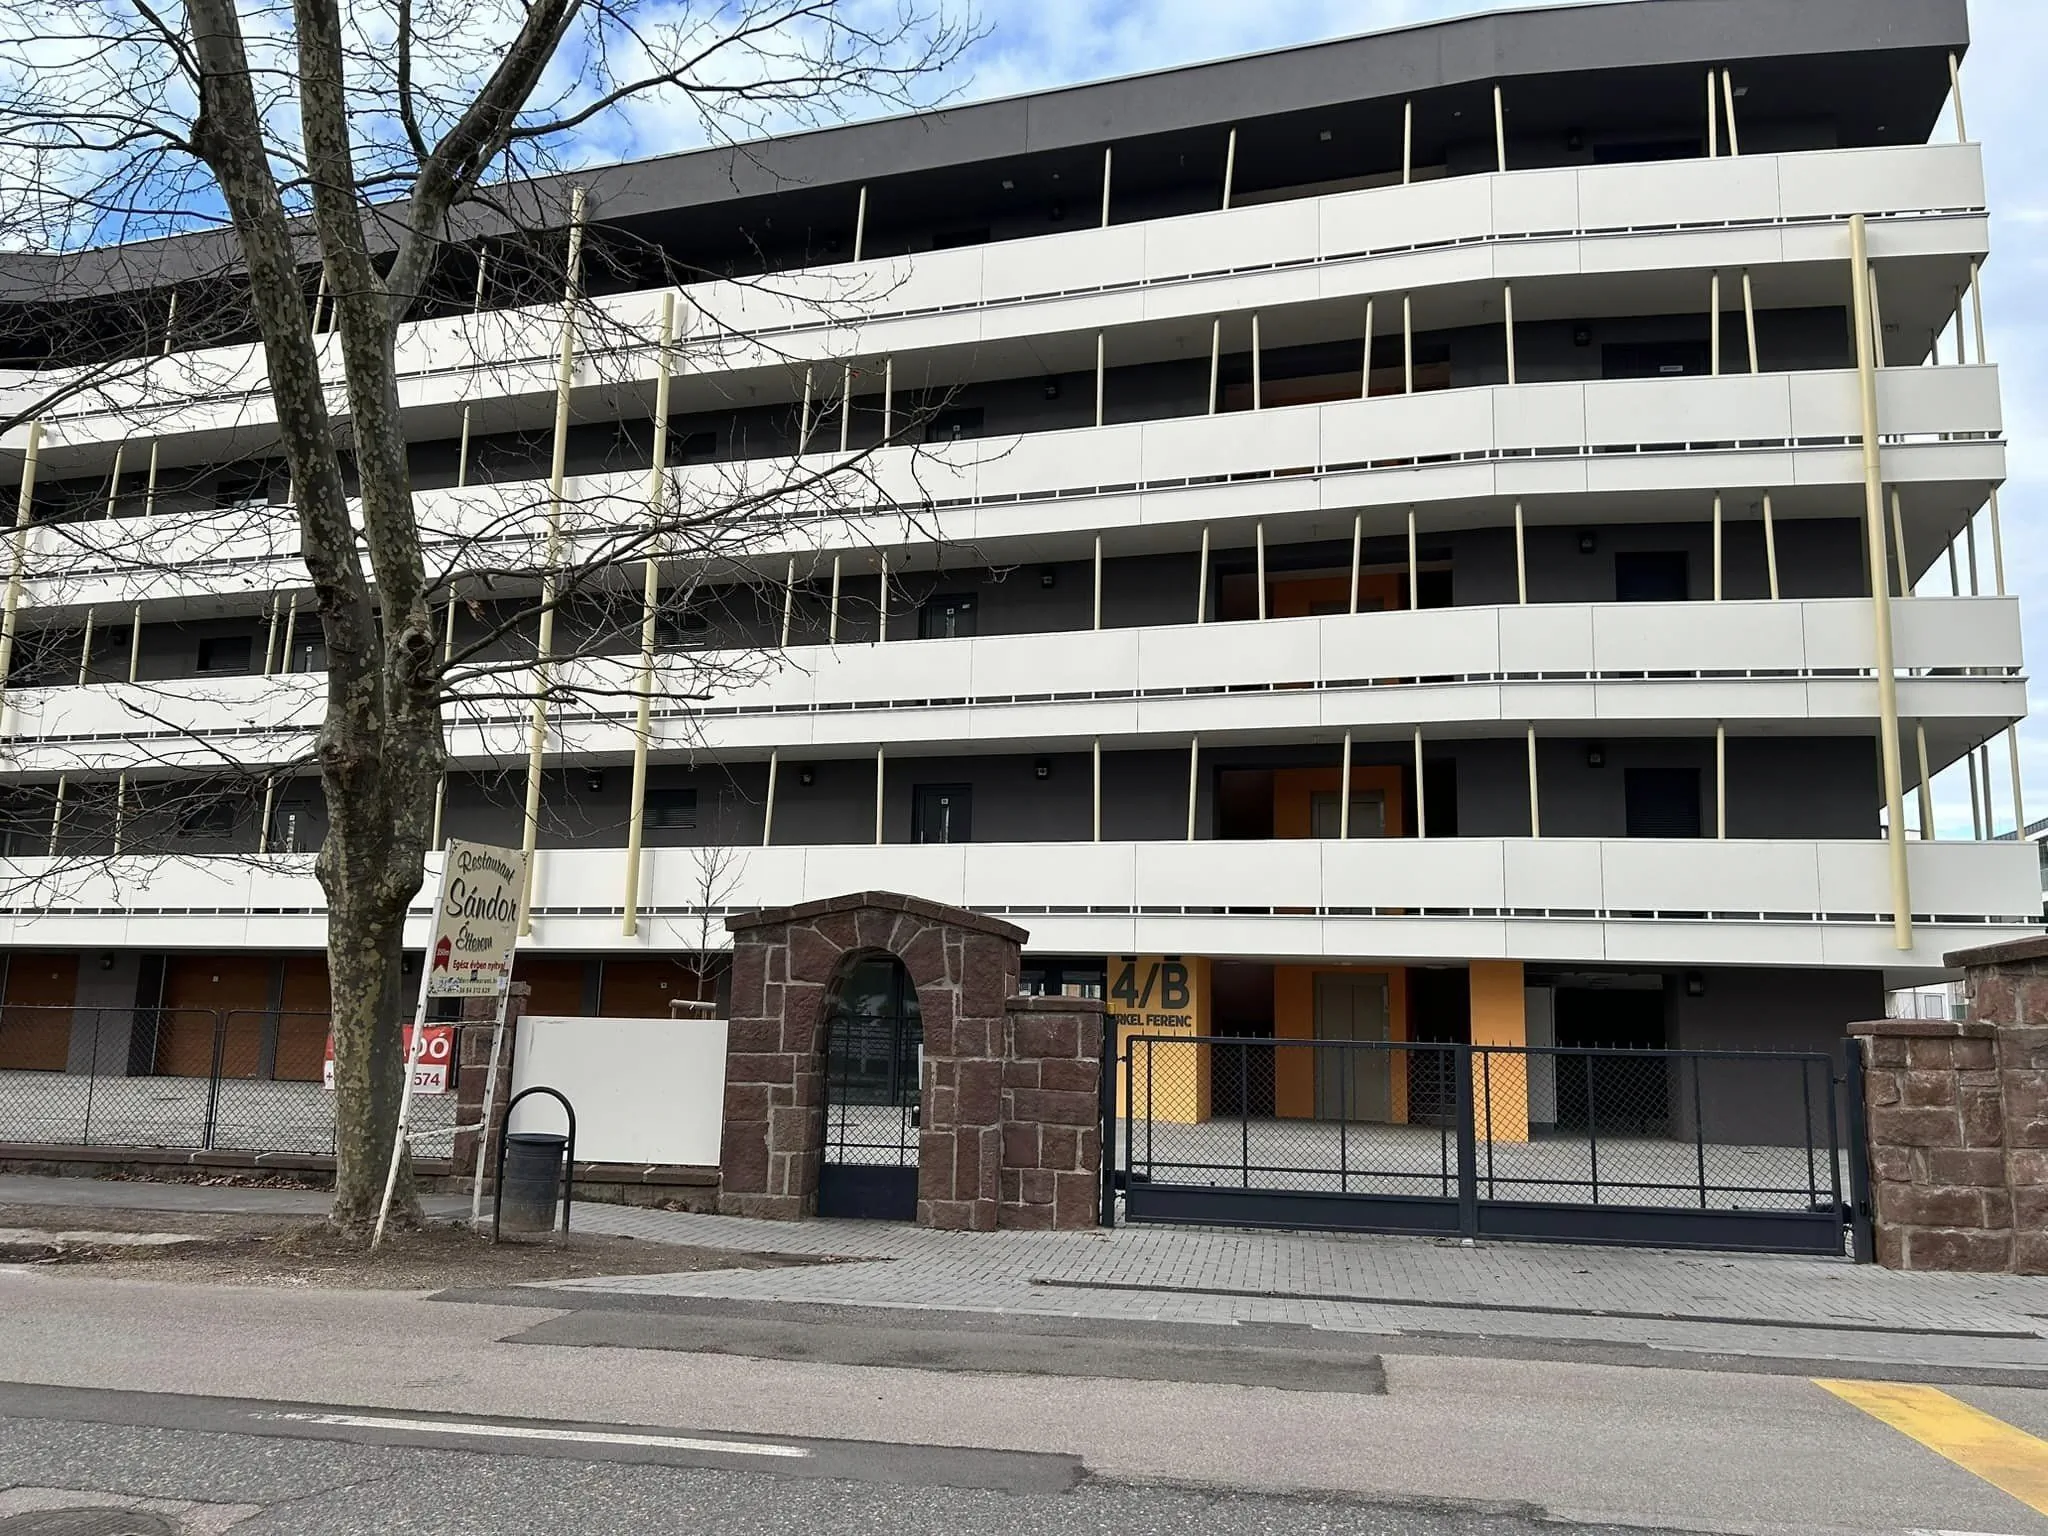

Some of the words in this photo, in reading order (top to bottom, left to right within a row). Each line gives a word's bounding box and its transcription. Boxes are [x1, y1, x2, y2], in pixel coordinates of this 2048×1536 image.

[457, 850, 515, 885] Restaurant
[446, 877, 517, 922] Sándor
[455, 920, 493, 952] Étterem
[1111, 963, 1190, 1009] 4/B
[1115, 1013, 1144, 1026] RKEL
[1146, 1014, 1192, 1027] FERENC
[414, 1072, 441, 1086] 574
